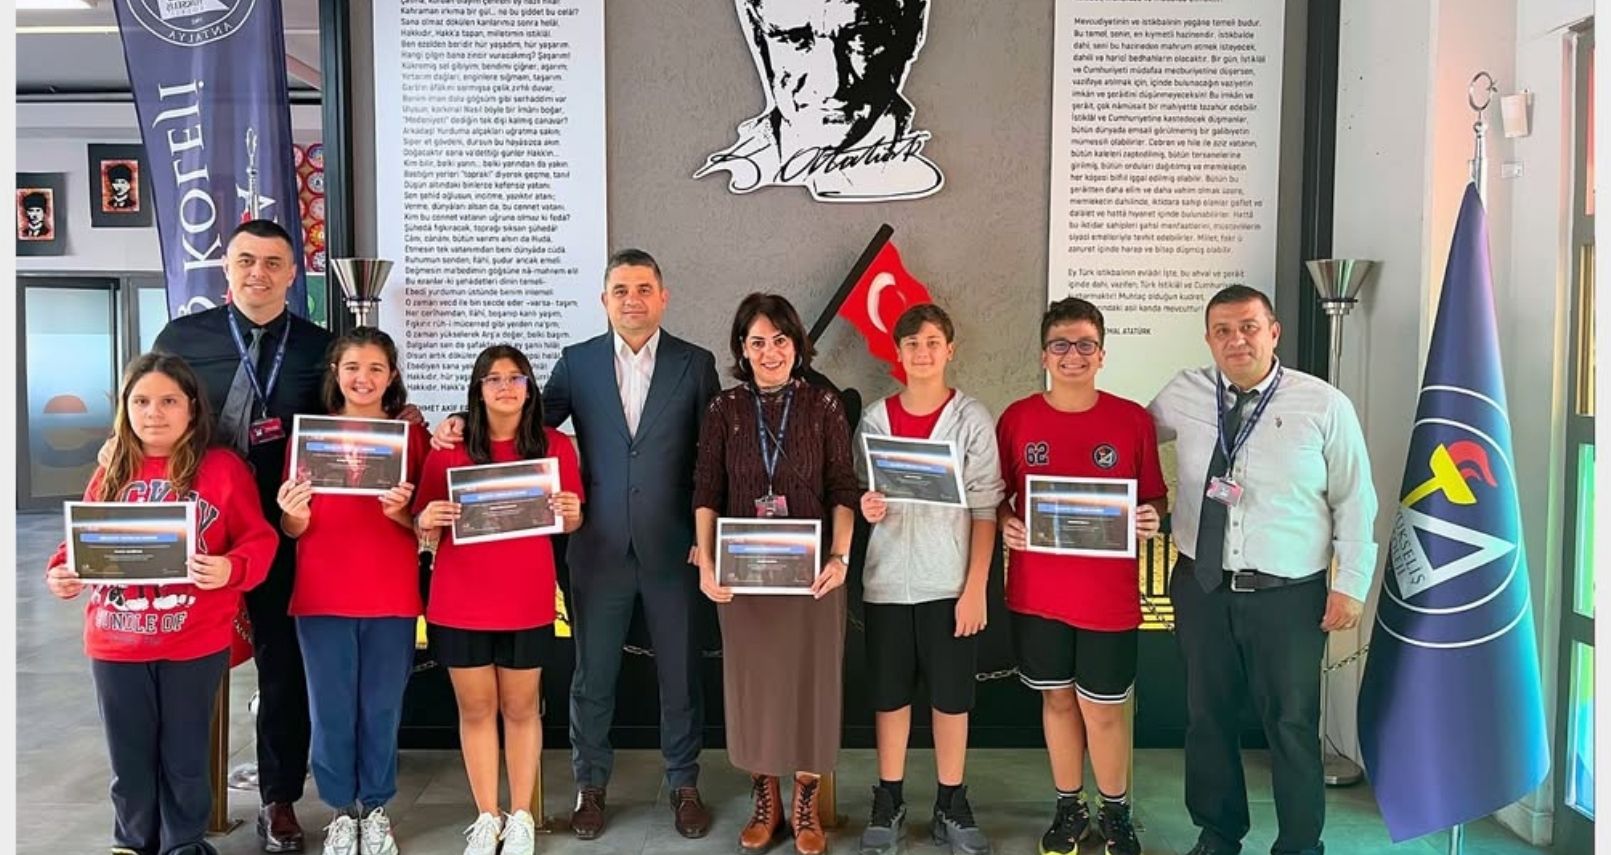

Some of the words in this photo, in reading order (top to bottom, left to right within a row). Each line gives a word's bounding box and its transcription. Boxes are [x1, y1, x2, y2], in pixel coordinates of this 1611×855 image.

[466, 7, 477, 15] bir
[497, 8, 508, 16] ne
[508, 7, 520, 16] bu
[545, 7, 556, 16] bu
[404, 160, 418, 168] Kim
[535, 160, 547, 169] da
[501, 202, 513, 211] bu
[404, 213, 419, 221] Kim
[419, 213, 431, 221] bu
[540, 213, 549, 222] ki
[436, 245, 449, 253] tek
[405, 299, 411, 307] O
[458, 299, 468, 307] ile
[468, 299, 482, 307] bin
[405, 309, 419, 317] Her
[406, 330, 412, 338] O
[1026, 442, 1049, 466] 62
[162, 611, 187, 631] OF
